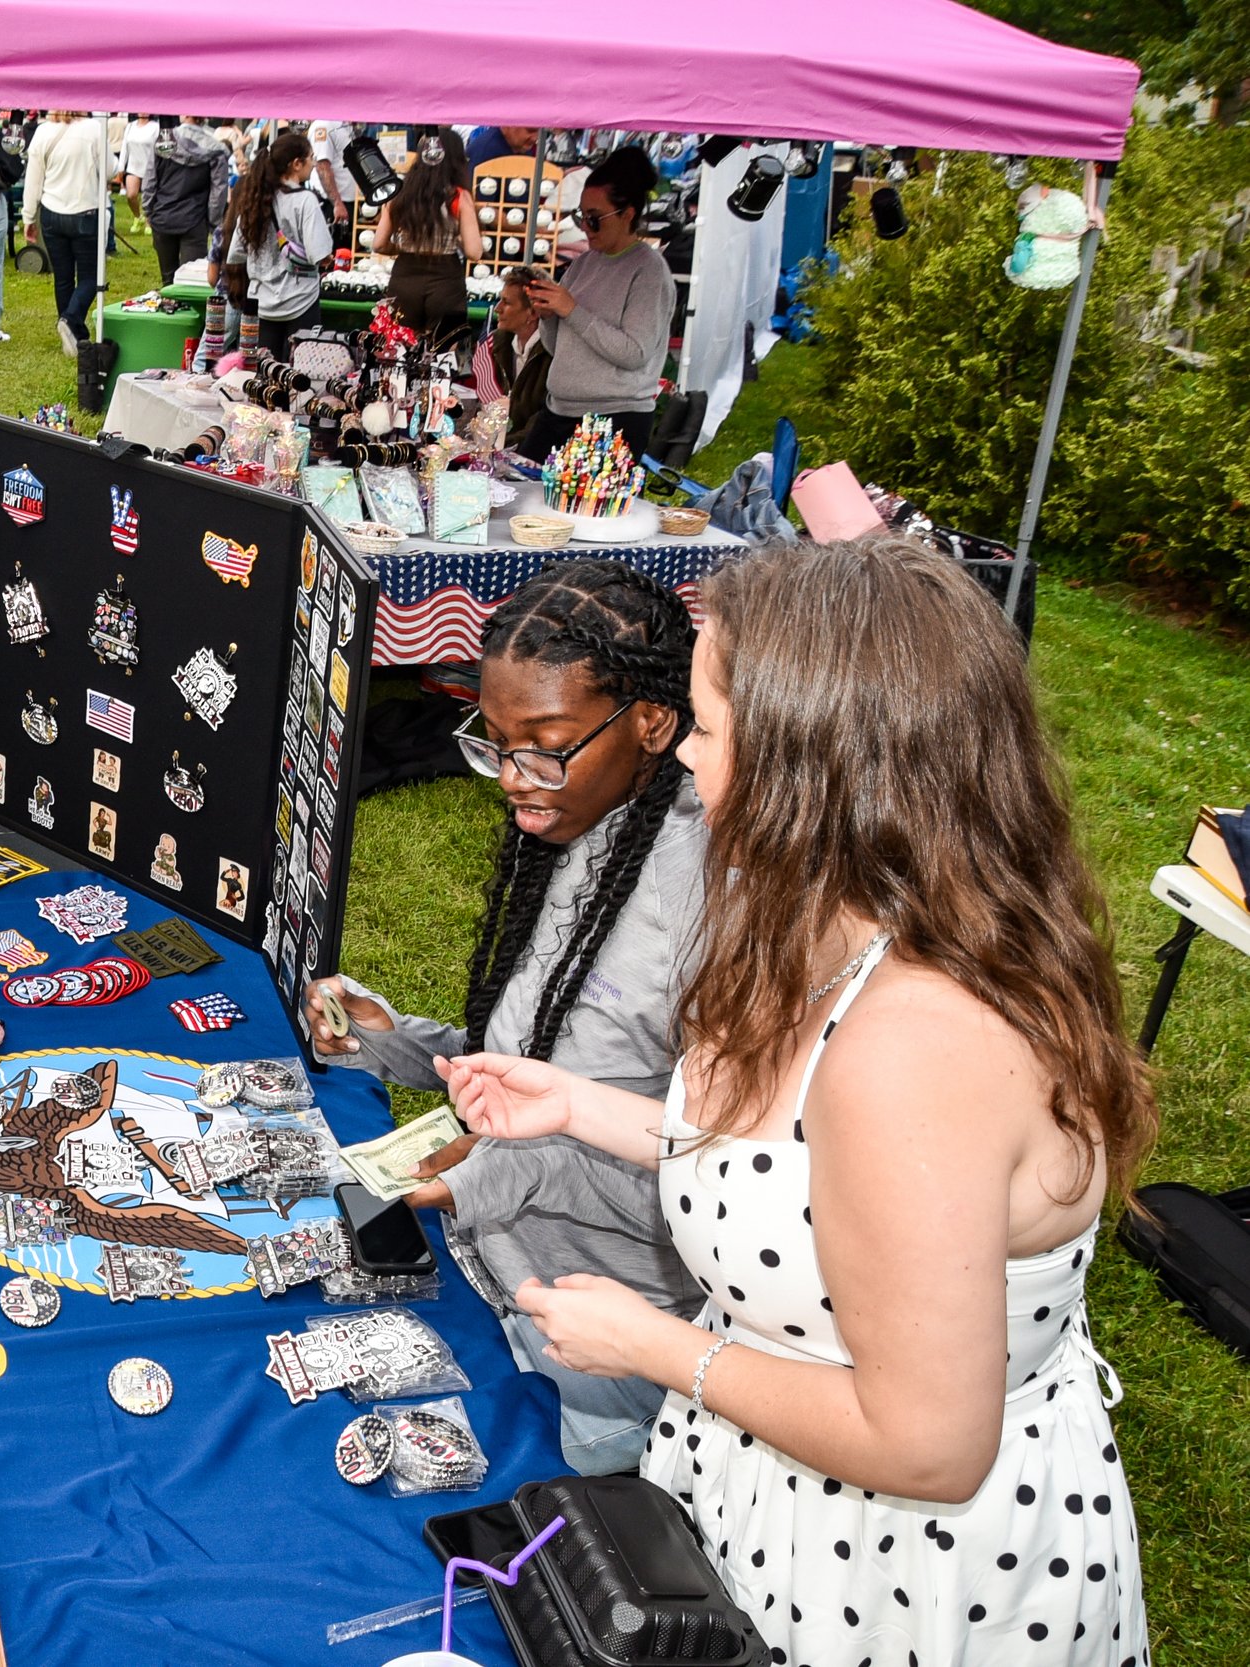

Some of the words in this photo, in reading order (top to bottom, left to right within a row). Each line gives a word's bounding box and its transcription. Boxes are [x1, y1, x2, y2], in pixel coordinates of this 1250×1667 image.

[2, 490, 22, 509] ISN'T
[22, 496, 42, 514] FREE
[4, 478, 43, 502] FREEDOM
[181, 677, 216, 719] EMPIRE
[32, 814, 53, 829] BOOTS
[95, 847, 110, 857] ARMY
[151, 871, 165, 884] BORN
[166, 878, 183, 890] READY
[64, 911, 88, 936] EMPIRE
[122, 936, 142, 954] U.S.
[139, 951, 168, 971] NAVY
[147, 934, 167, 953] U.S.
[168, 948, 200, 967] NAVY
[70, 1143, 83, 1180] EMPIRE
[185, 1144, 208, 1186] EMPIRE
[109, 1250, 130, 1291] EMPIRE
[3, 1289, 23, 1313] 250
[282, 1345, 306, 1392] EMPIRE
[338, 1441, 362, 1474] 250
